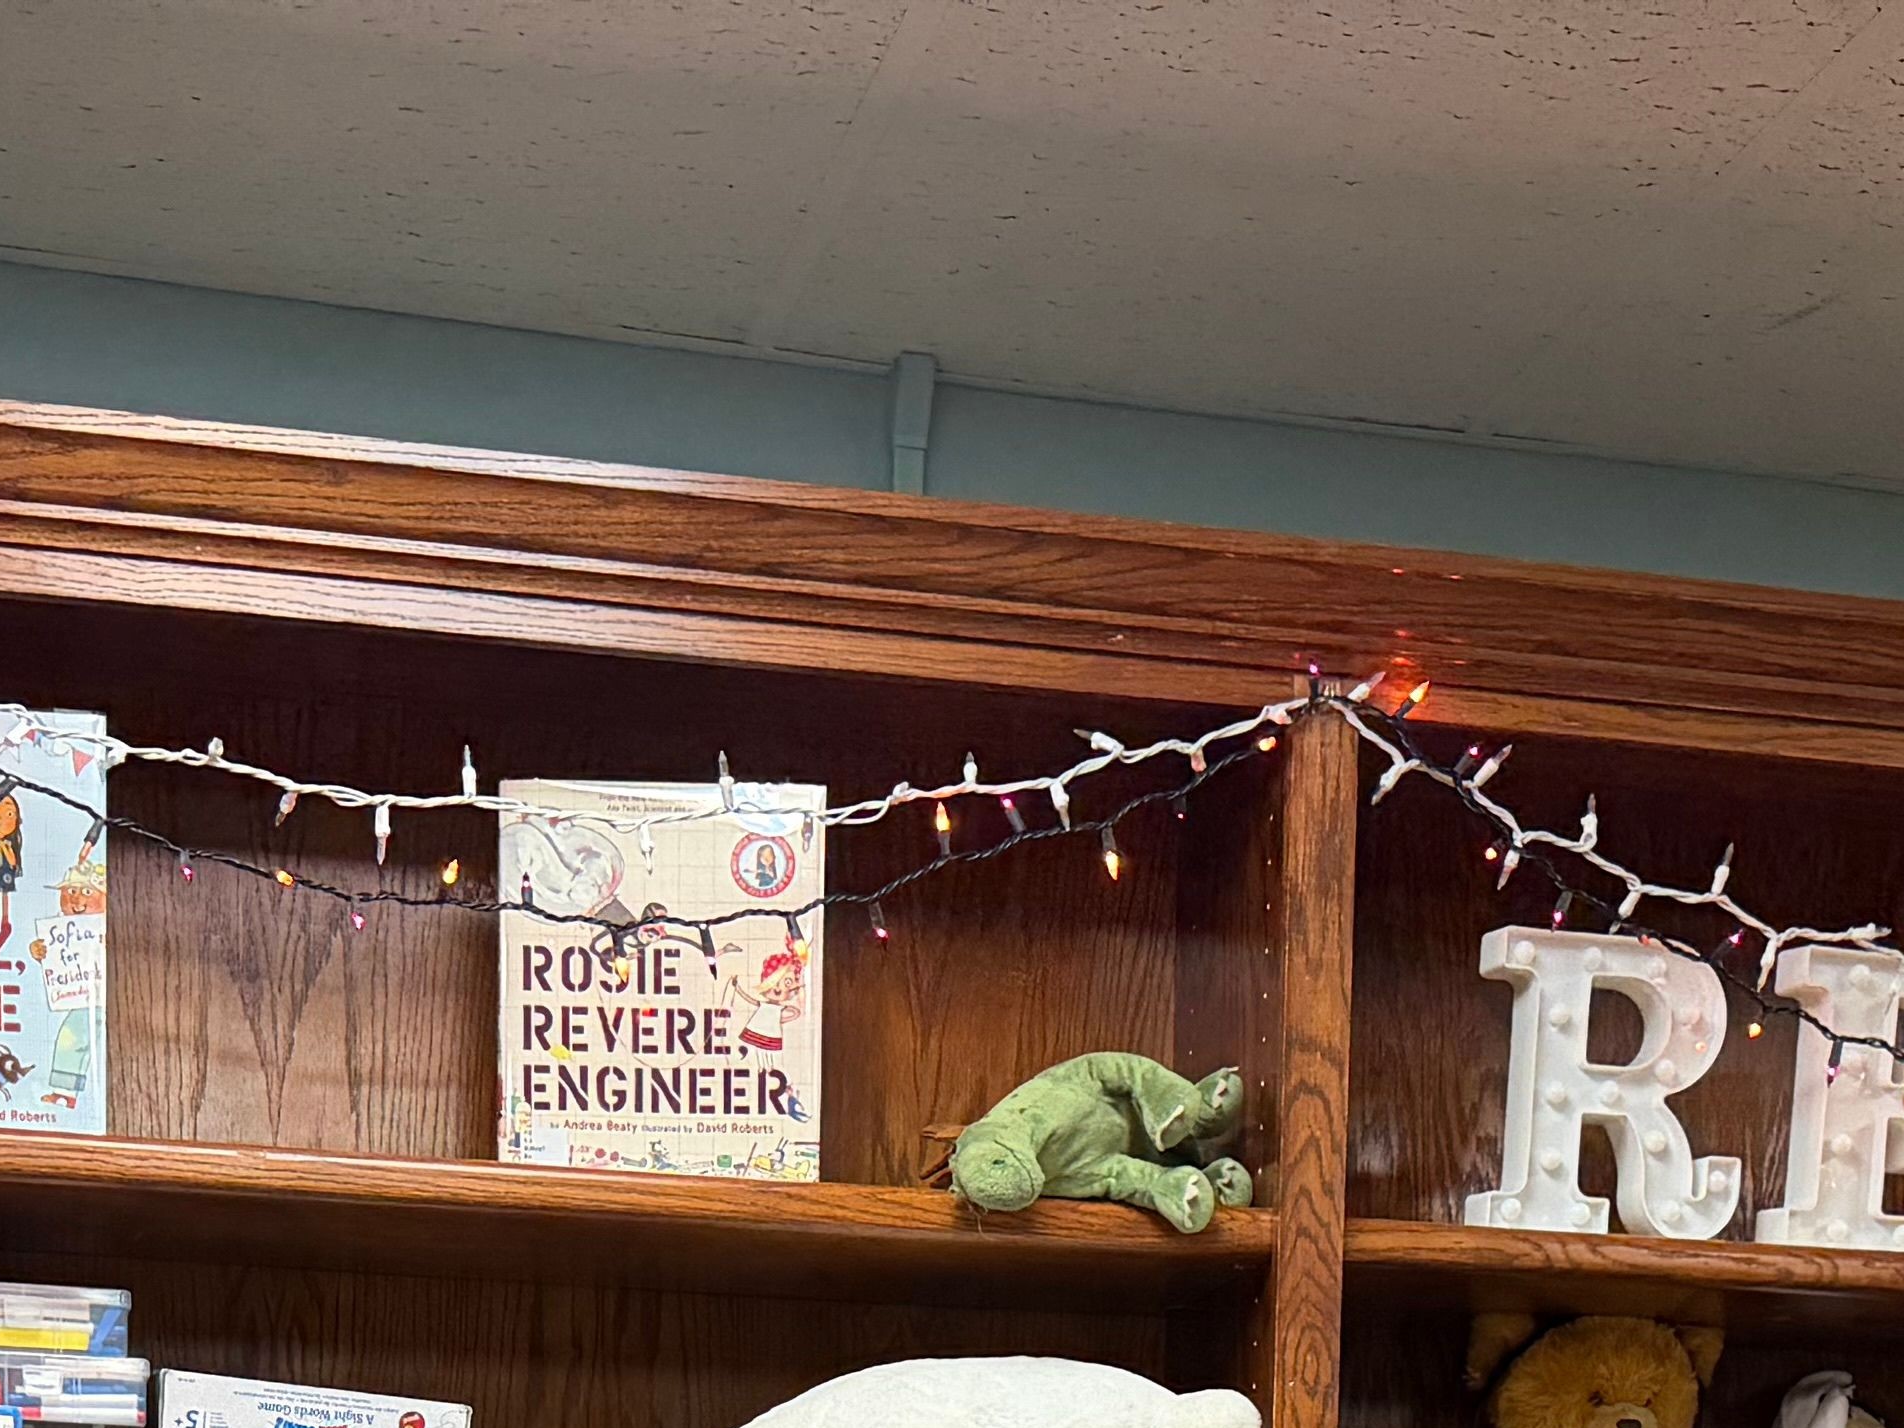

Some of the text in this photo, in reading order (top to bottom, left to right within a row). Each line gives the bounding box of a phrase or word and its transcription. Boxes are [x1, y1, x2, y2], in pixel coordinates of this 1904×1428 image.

[48, 921, 96, 946] Sofia
[60, 949, 80, 966] for
[522, 945, 681, 995] ROSIE
[522, 1004, 748, 1061] REVERE,
[523, 1064, 788, 1115] ENGINEER
[10, 1111, 57, 1124] Roberts
